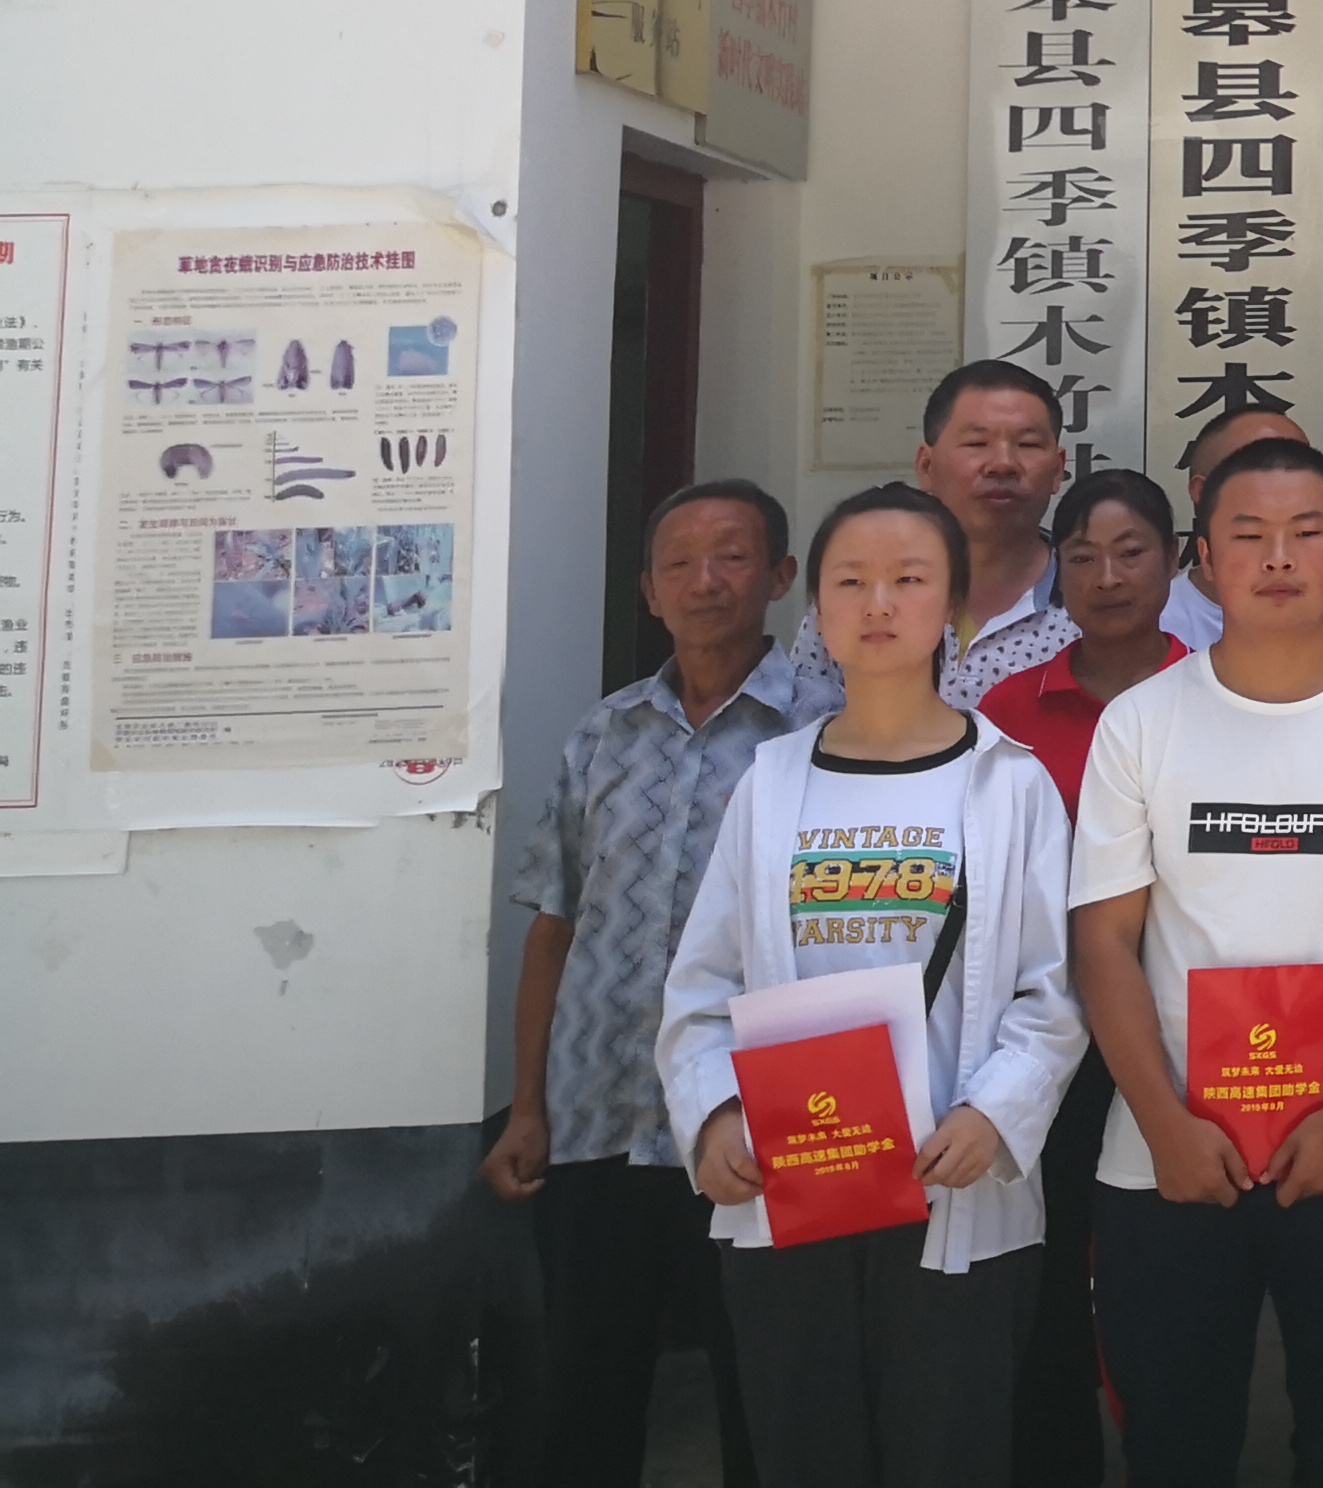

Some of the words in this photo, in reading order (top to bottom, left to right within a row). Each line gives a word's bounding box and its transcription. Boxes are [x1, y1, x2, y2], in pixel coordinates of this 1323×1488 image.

[178, 250, 416, 275] 草地贪夜蛾识别与应急防治技术挂图
[798, 825, 946, 850] VINTAGE
[789, 856, 937, 904] 1978
[1203, 1080, 1321, 1100] 陕西高速集团助学金
[772, 1137, 896, 1170] 陕西高速集团助学金
